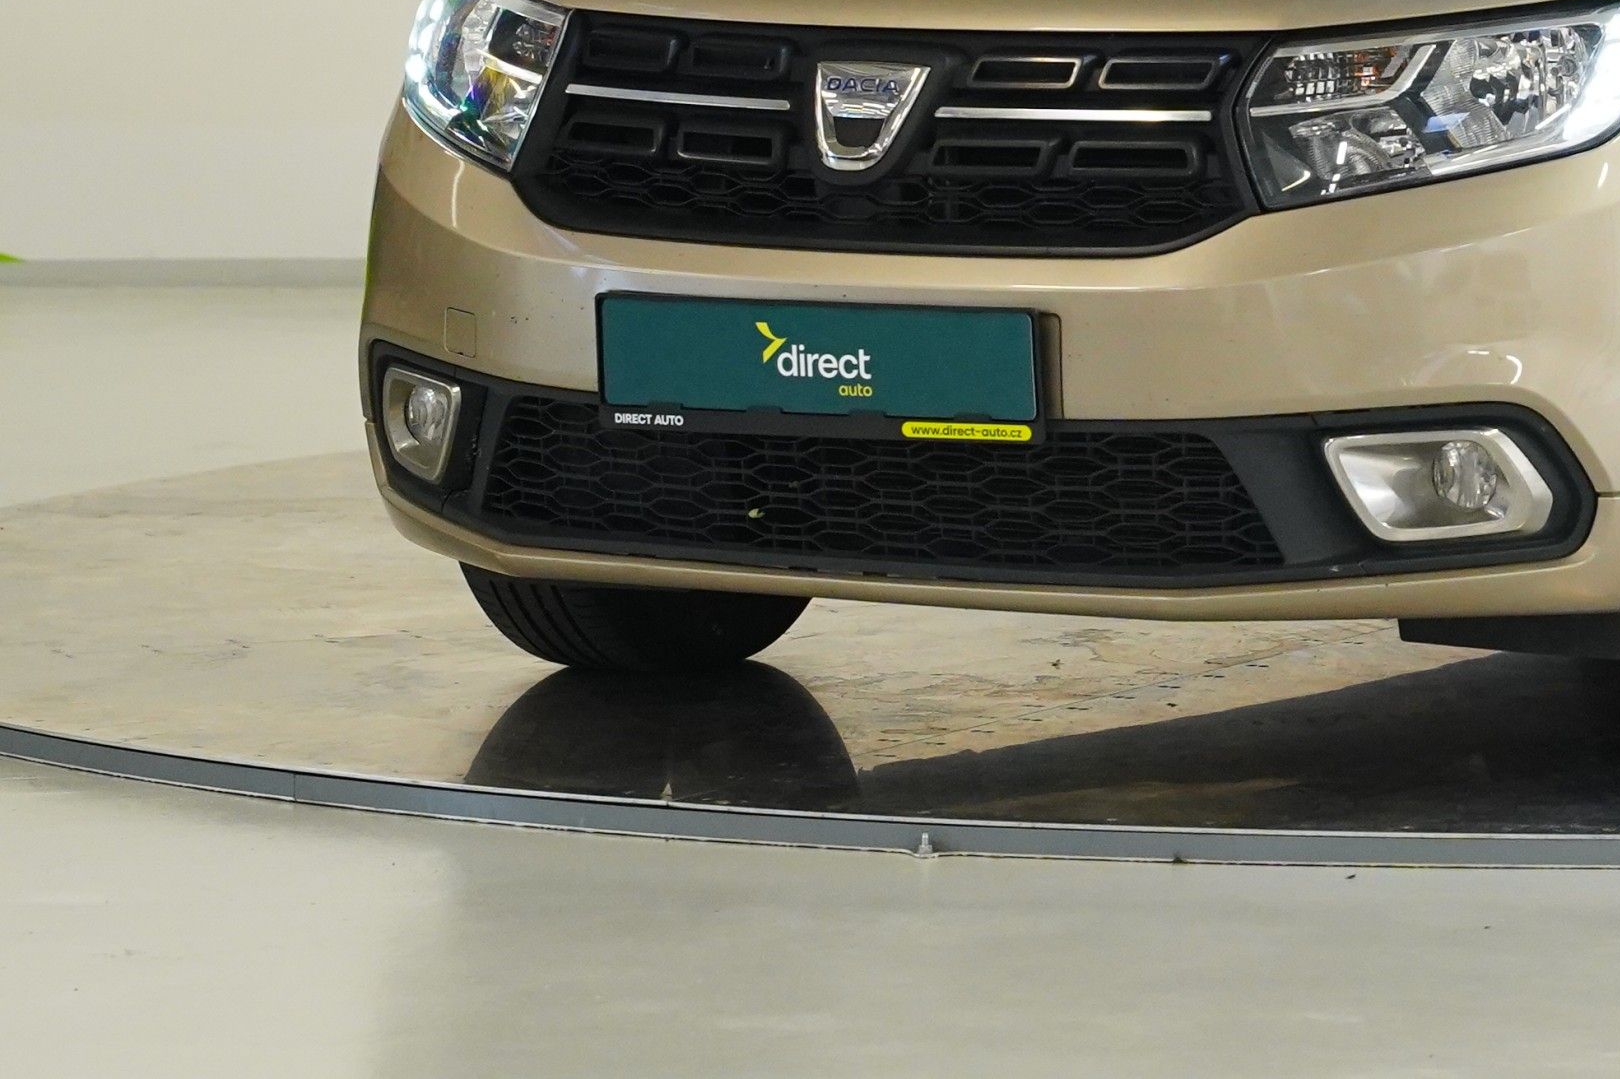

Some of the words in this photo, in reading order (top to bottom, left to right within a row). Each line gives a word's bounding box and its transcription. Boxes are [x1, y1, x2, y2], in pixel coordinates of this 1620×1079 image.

[827, 76, 900, 94] DACIA
[777, 344, 872, 380] direct
[838, 383, 873, 397] auto
[614, 412, 653, 425] DIRECT
[654, 414, 684, 426] AUTO
[911, 425, 1023, 438] www.direct-auto.cz
